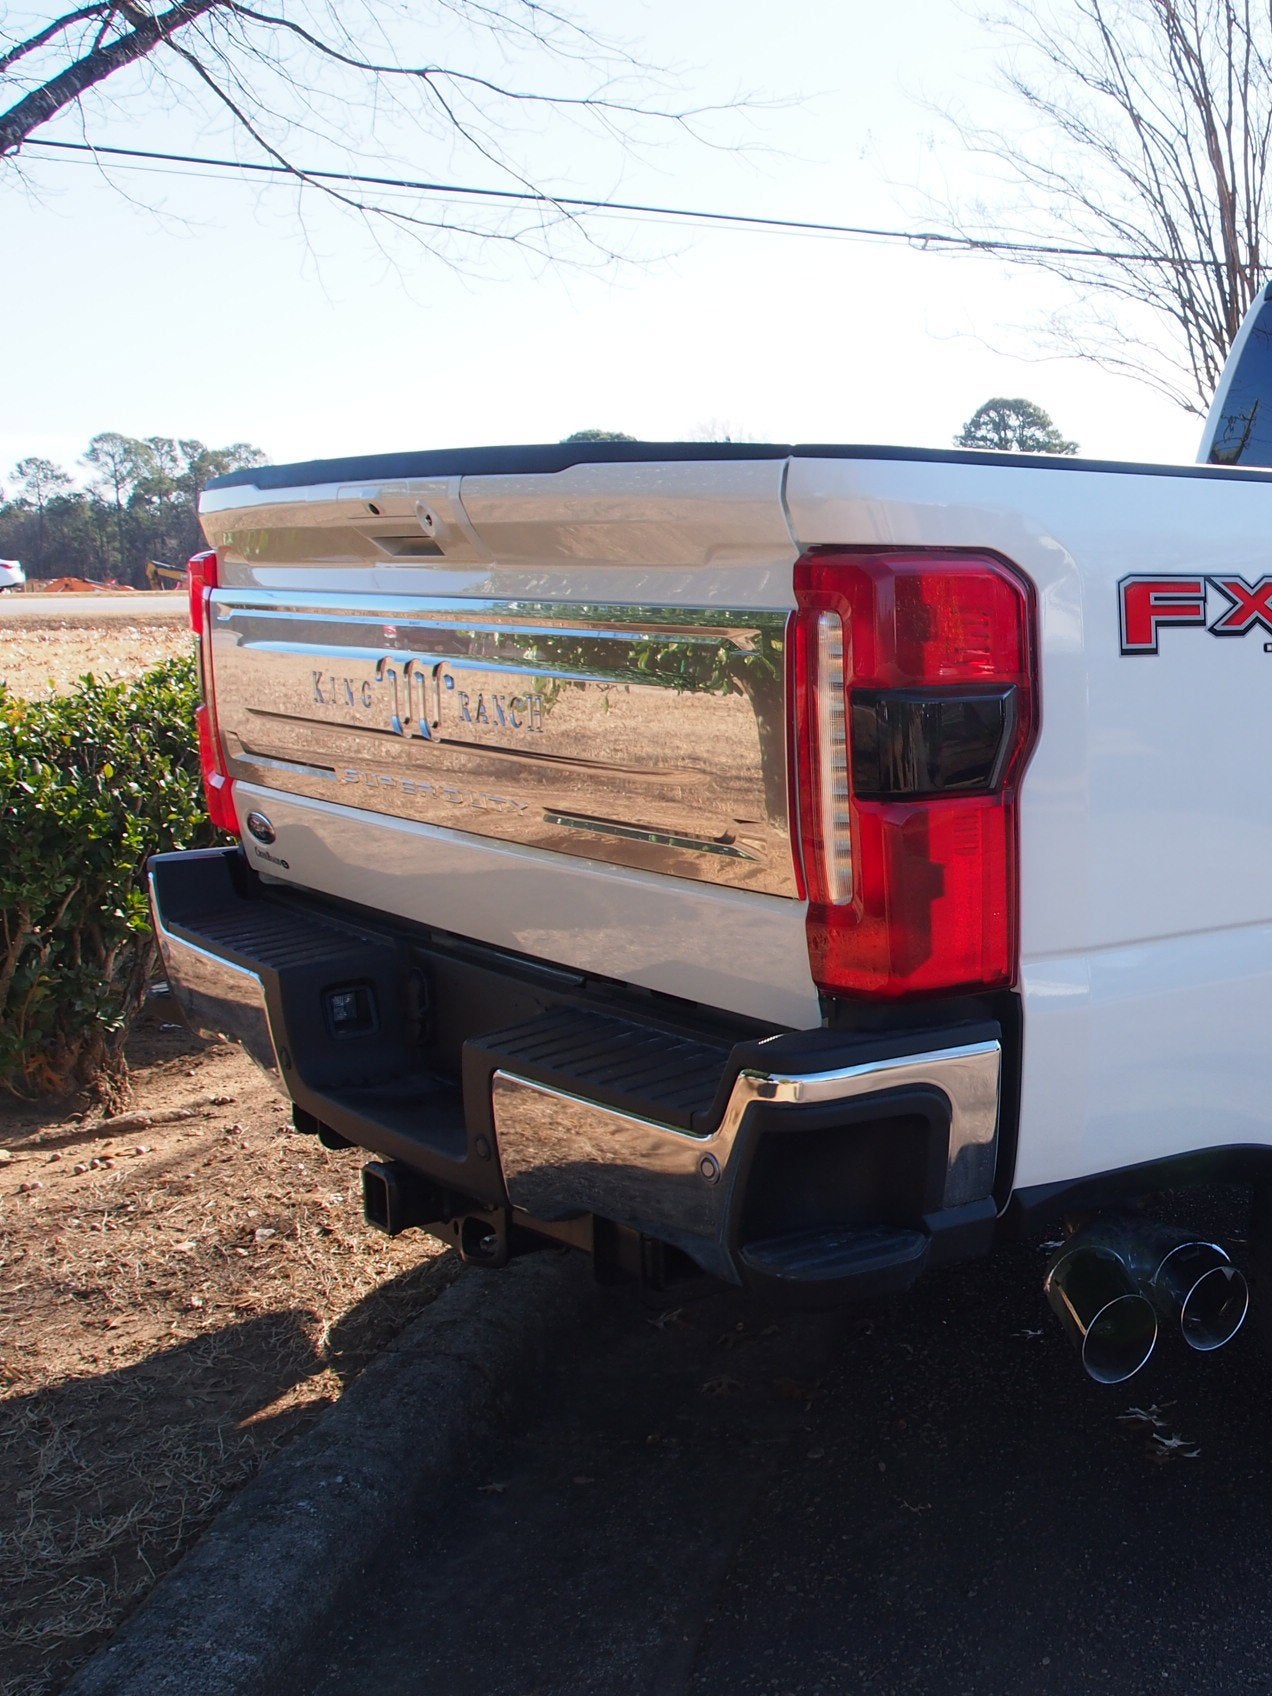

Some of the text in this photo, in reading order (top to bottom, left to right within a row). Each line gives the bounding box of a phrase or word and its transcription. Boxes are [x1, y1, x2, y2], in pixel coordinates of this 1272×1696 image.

[312, 670, 544, 733] KING RANCH
[343, 768, 528, 816] SUPER DUTY
